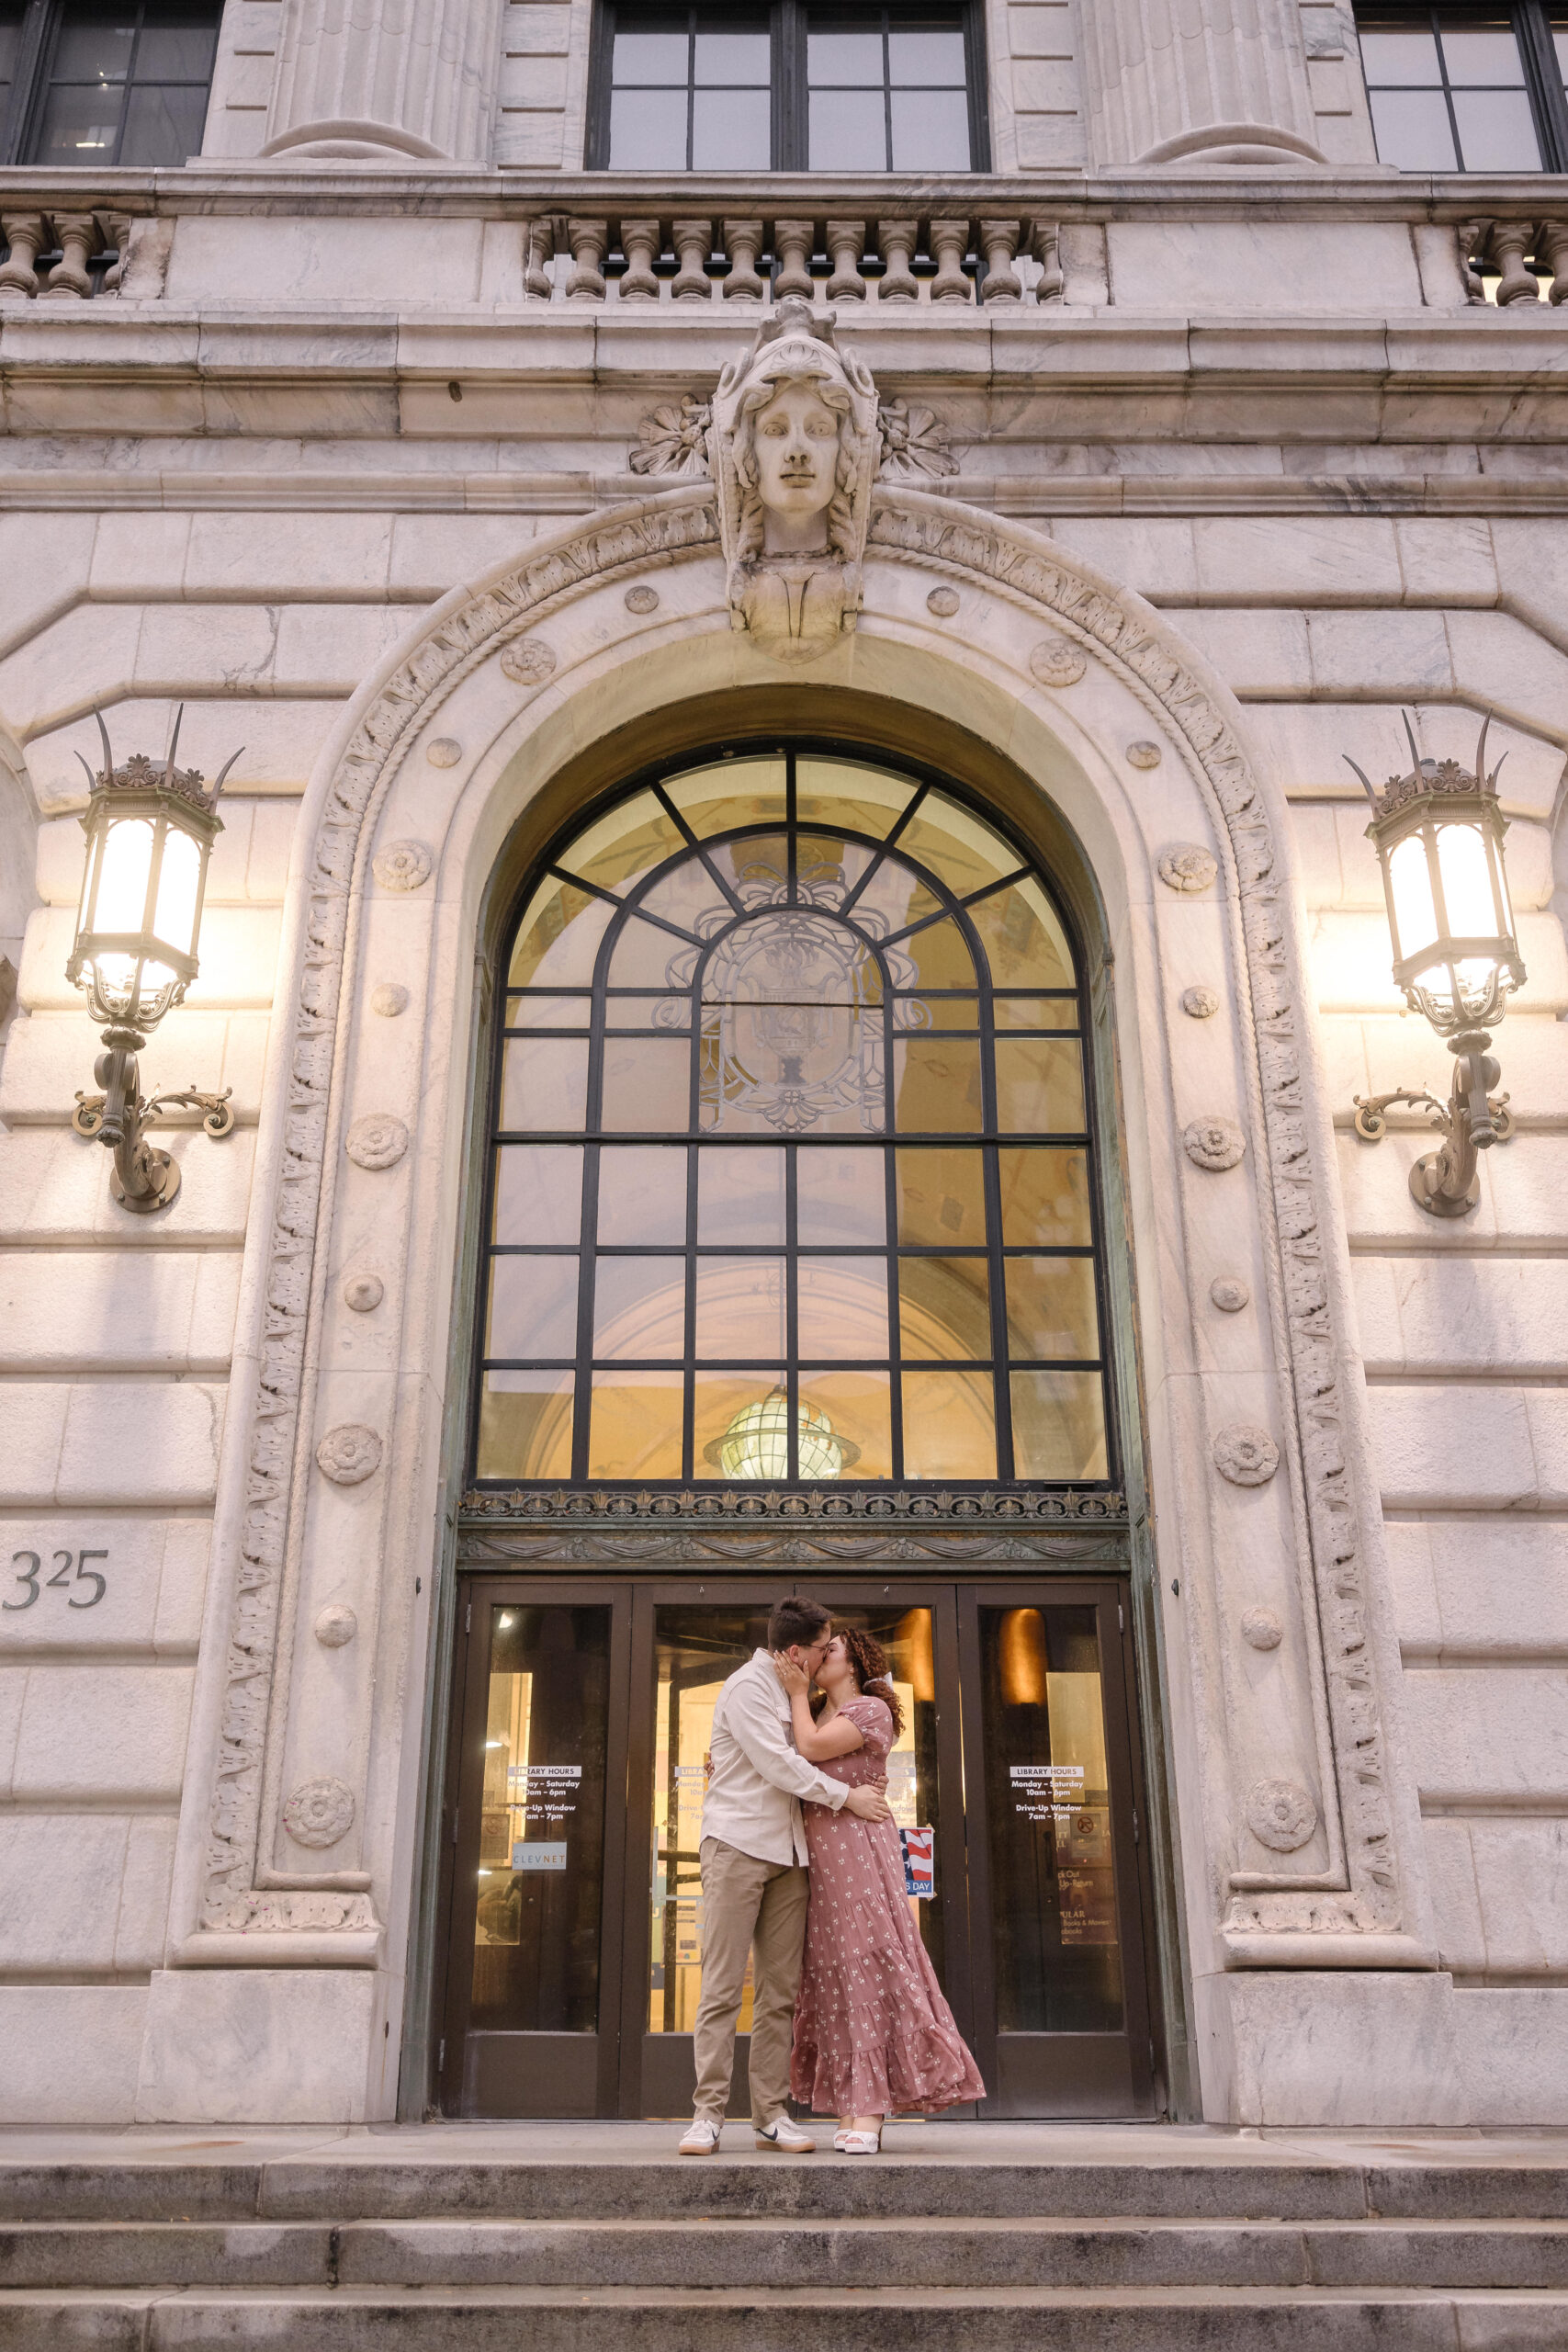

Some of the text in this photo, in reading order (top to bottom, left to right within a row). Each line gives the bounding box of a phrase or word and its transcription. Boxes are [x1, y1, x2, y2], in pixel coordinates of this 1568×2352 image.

[2, 1549, 109, 1611] 325
[546, 1780, 581, 1789] Saturday
[1011, 1780, 1043, 1789] Monday
[1049, 1780, 1084, 1789] Saturday
[549, 1789, 567, 1797] 6pm
[1054, 1789, 1071, 1797] 6pm
[510, 1804, 543, 1813] Drive-Up
[1016, 1804, 1082, 1813] Drive-Up Window
[547, 1813, 564, 1821] 7pm
[1054, 1813, 1070, 1821] 7pm
[513, 1855, 566, 1864] CLEVNET
[912, 1882, 931, 1891] DAY
